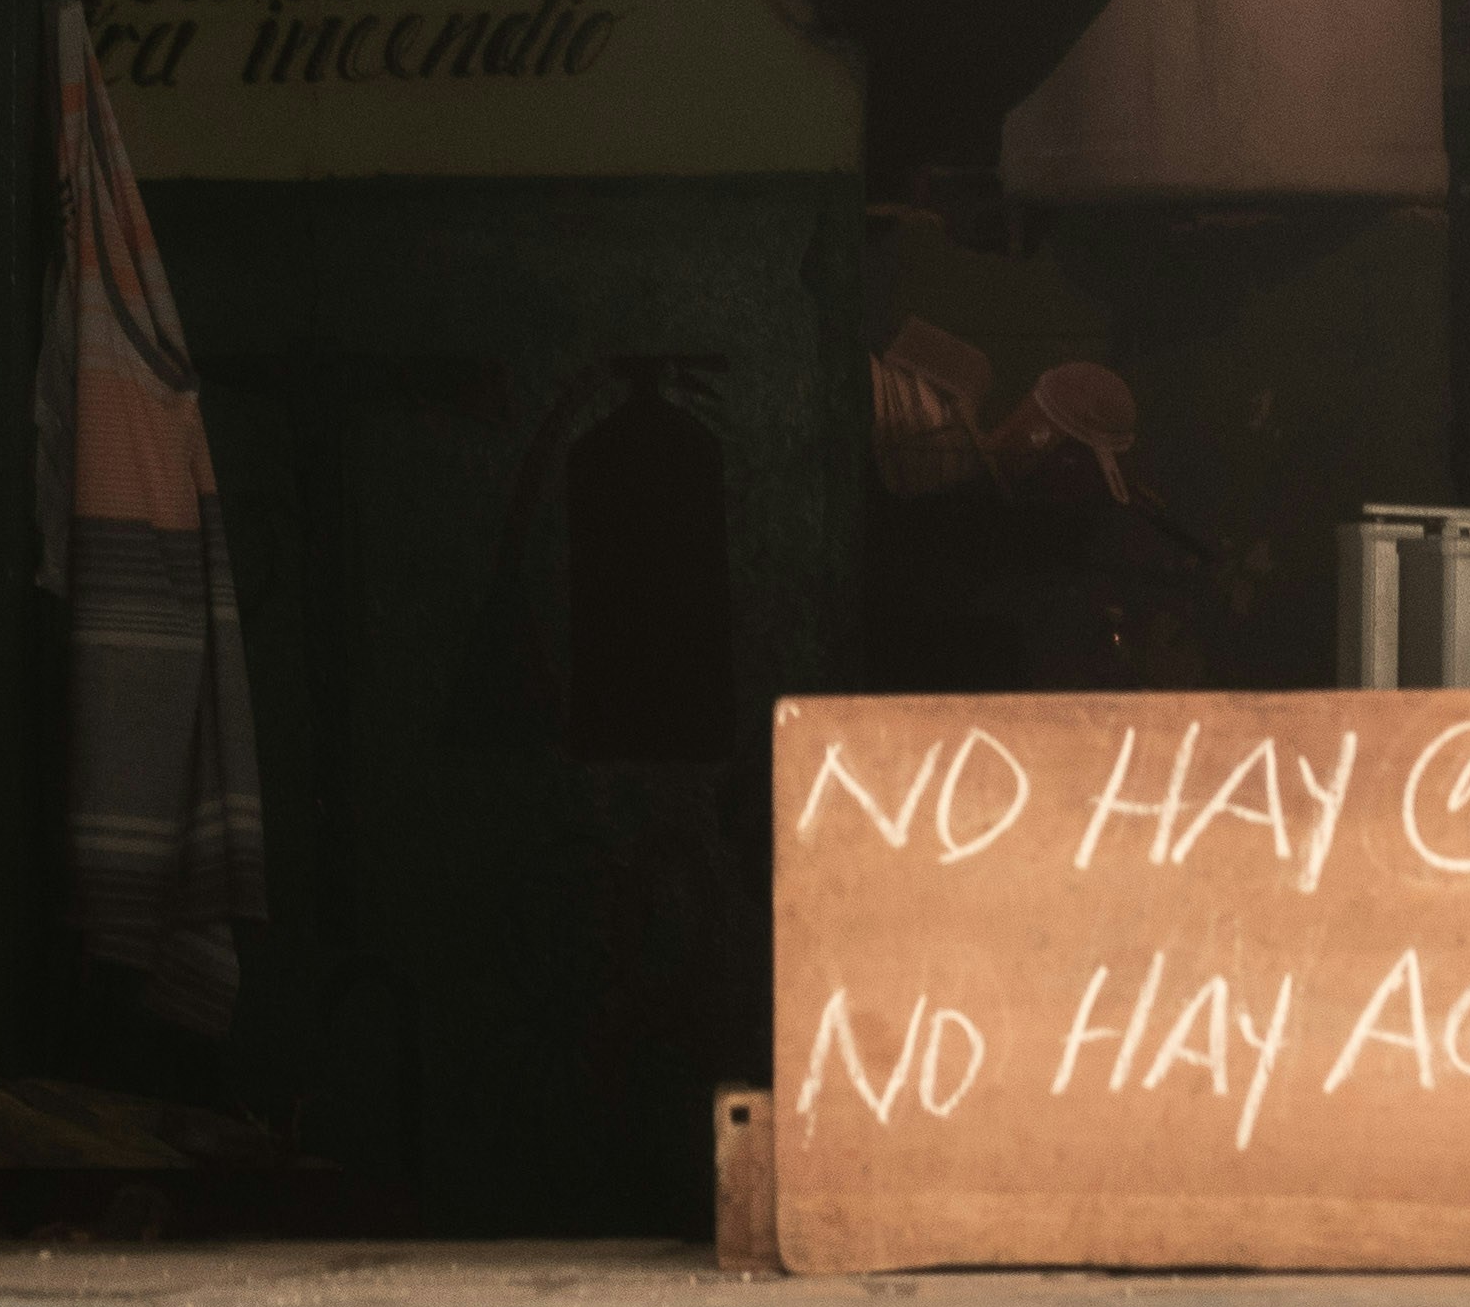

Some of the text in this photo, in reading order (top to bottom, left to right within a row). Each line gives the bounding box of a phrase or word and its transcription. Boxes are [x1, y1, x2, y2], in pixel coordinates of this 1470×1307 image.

[796, 727, 1028, 864] NO
[1075, 722, 1356, 894] HAY
[798, 990, 986, 1126] NO
[1051, 952, 1294, 1152] HAY
